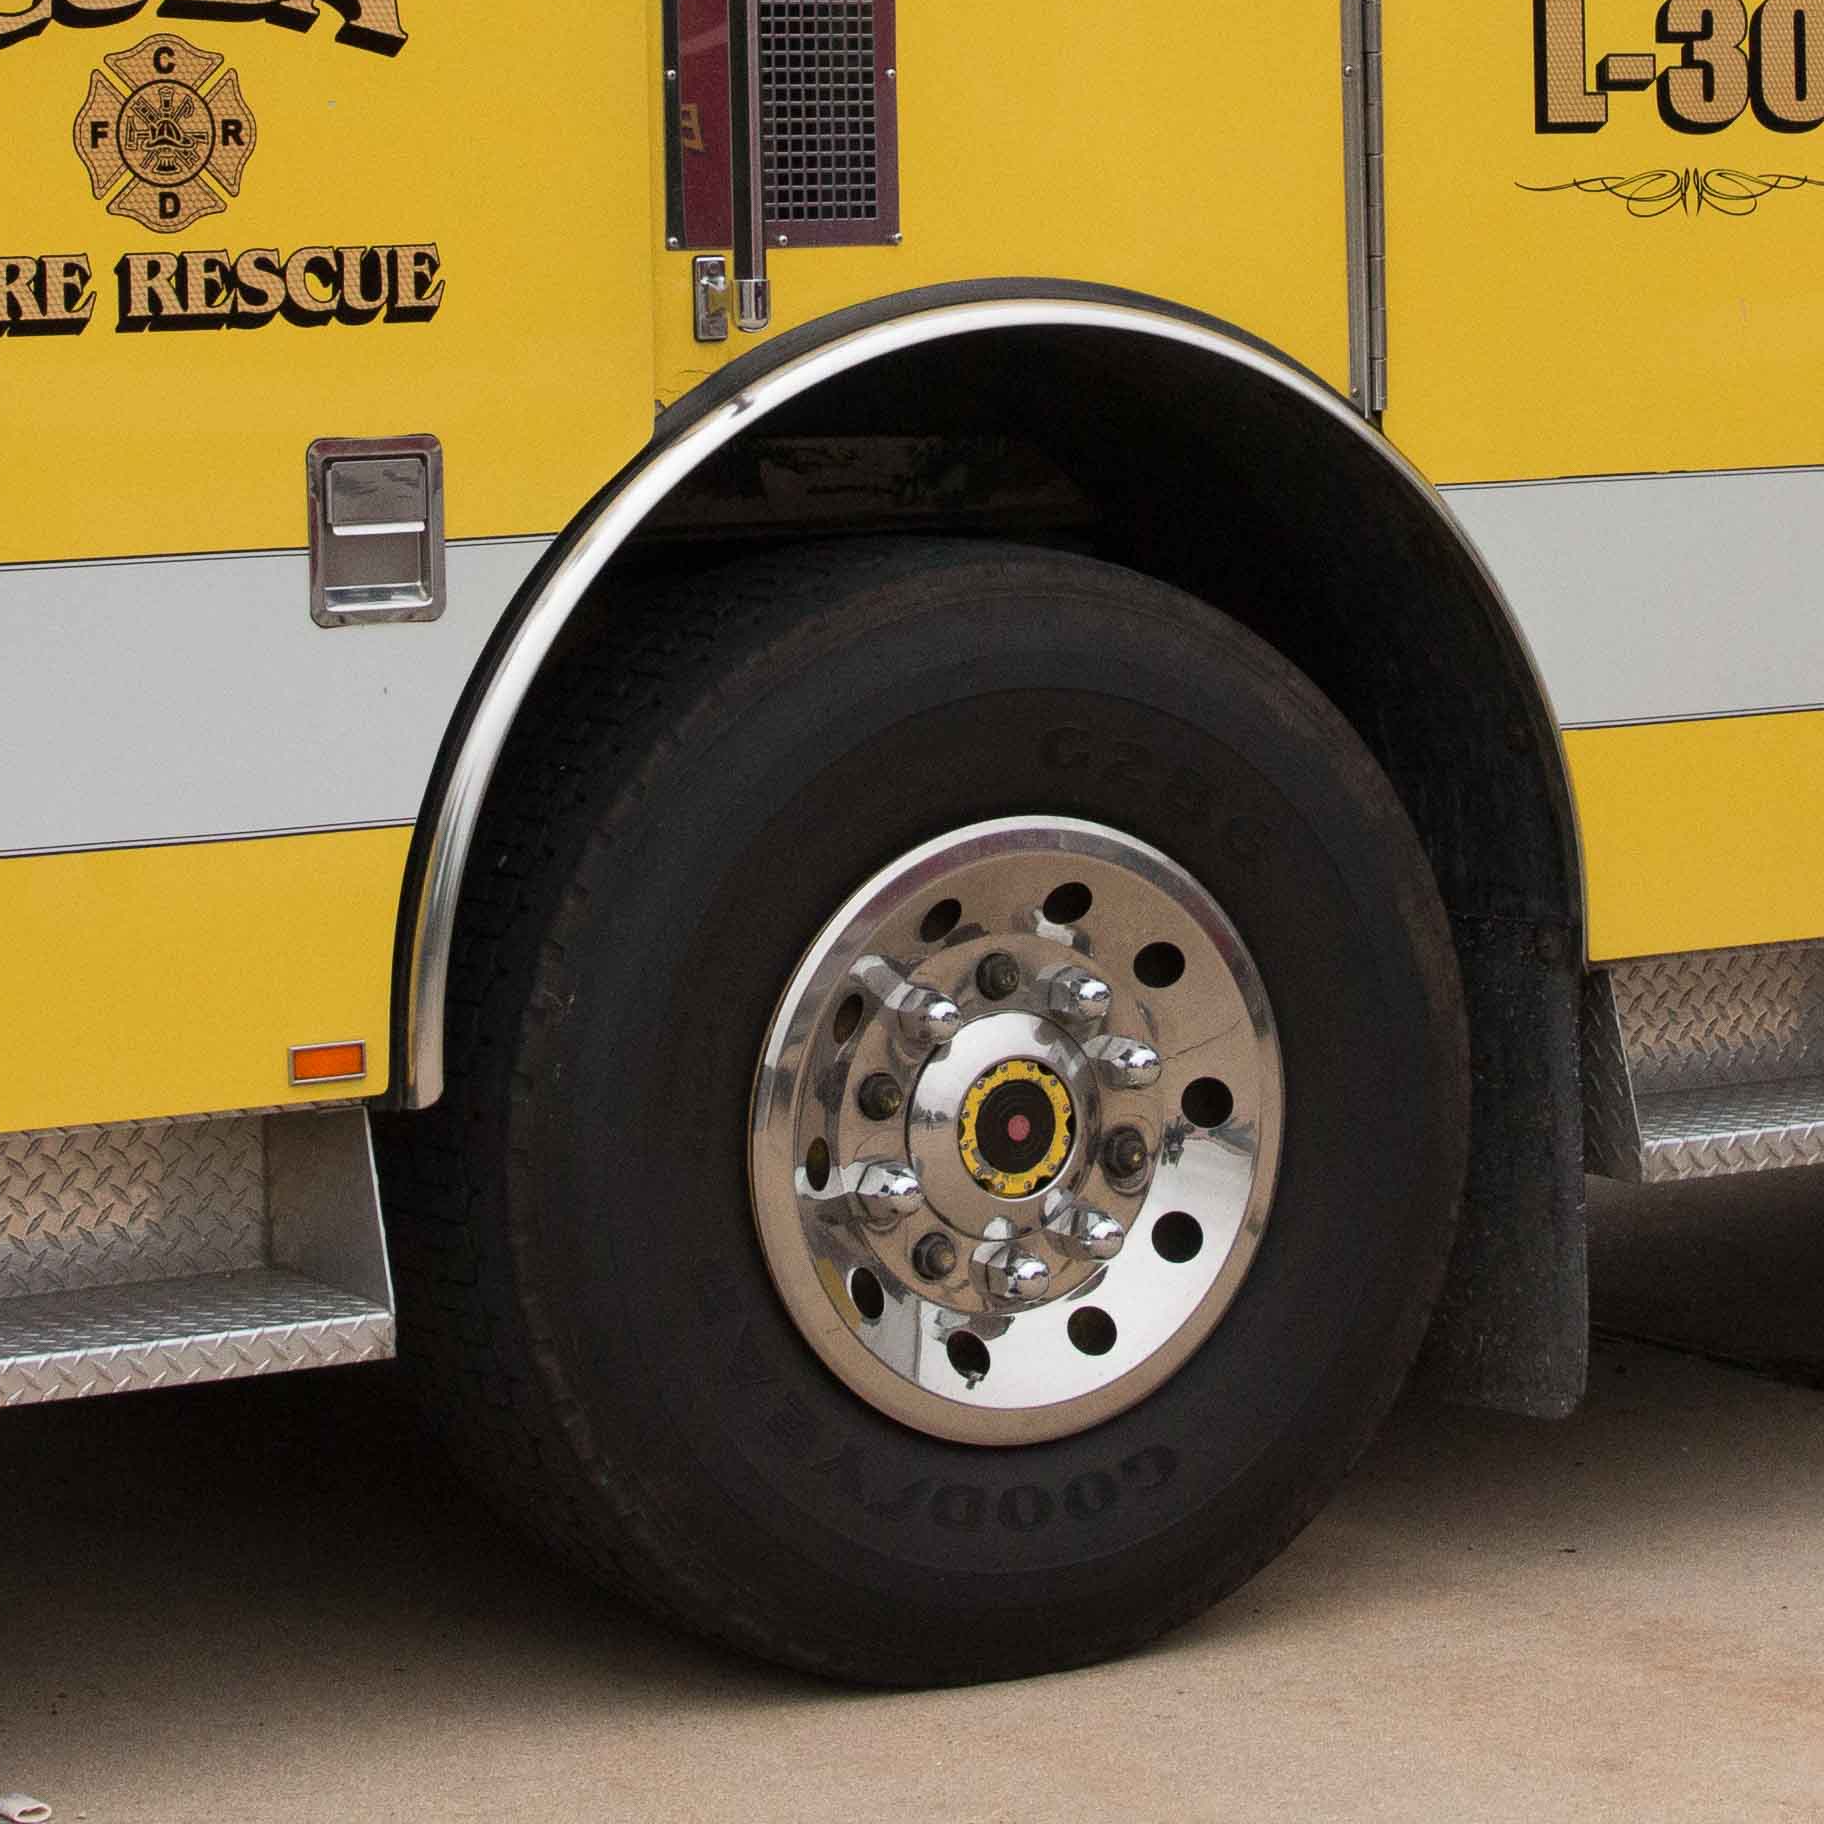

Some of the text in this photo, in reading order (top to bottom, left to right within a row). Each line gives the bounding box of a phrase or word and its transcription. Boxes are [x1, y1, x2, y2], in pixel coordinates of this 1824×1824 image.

[152, 44, 176, 75] C
[89, 120, 110, 150] F
[221, 118, 245, 147] R
[158, 191, 182, 220] D
[115, 242, 446, 333] RESCUE
